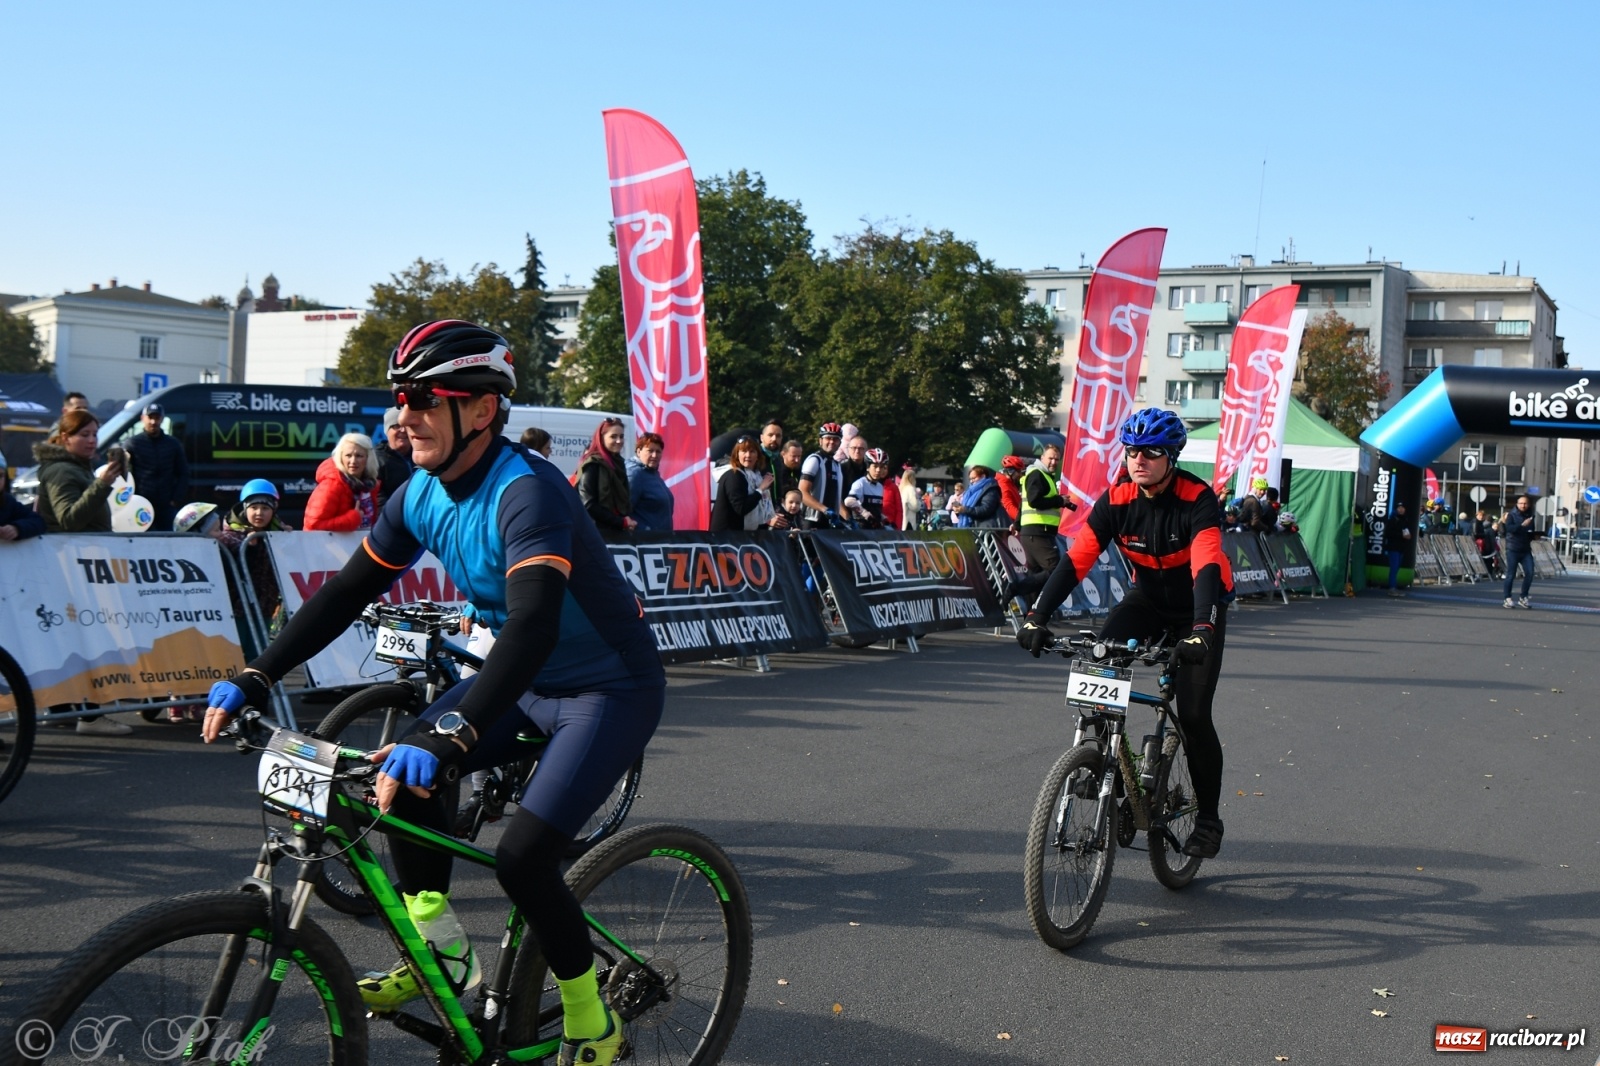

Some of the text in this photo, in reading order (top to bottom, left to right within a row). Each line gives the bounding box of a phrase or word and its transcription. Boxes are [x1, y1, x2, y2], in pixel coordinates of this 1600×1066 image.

[465, 355, 491, 365] GIRO
[251, 393, 357, 414] bike atelier
[1509, 390, 1568, 418] bike
[1368, 466, 1390, 555] bike atelier
[77, 558, 177, 584] TAURUS
[841, 541, 966, 585] TREZADO
[869, 598, 936, 628] USZCZELNIAMY
[711, 613, 791, 644] NAJLEPSZYCH
[382, 634, 415, 653] 2996
[1077, 682, 1119, 701] 2724
